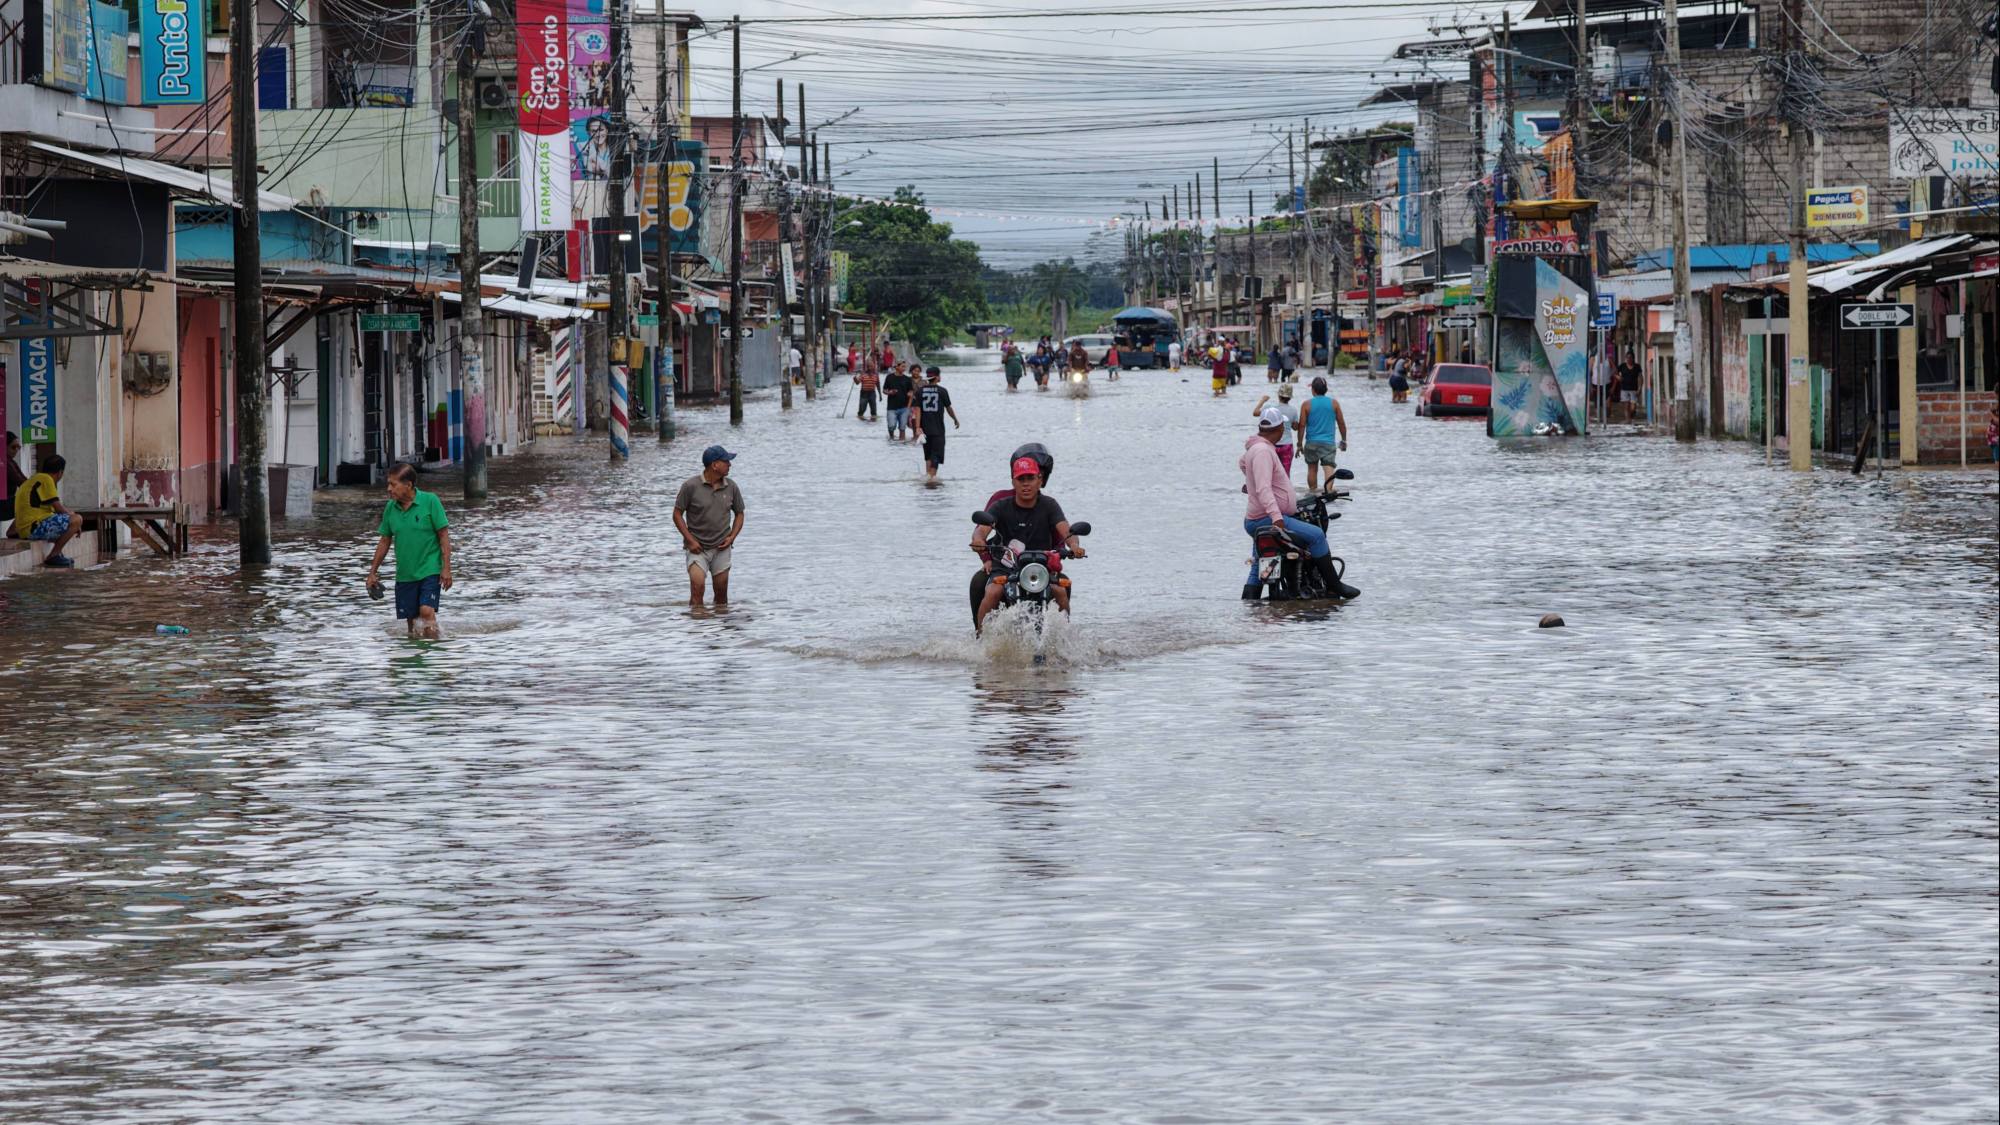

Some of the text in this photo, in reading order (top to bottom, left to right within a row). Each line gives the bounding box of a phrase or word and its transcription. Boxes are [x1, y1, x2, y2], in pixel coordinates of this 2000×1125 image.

[540, 15, 565, 110] Gregorio
[526, 66, 545, 109] San
[540, 142, 551, 225] FARMACIAS
[1858, 311, 1898, 320] DOBLE VIA
[922, 392, 939, 412] 23
